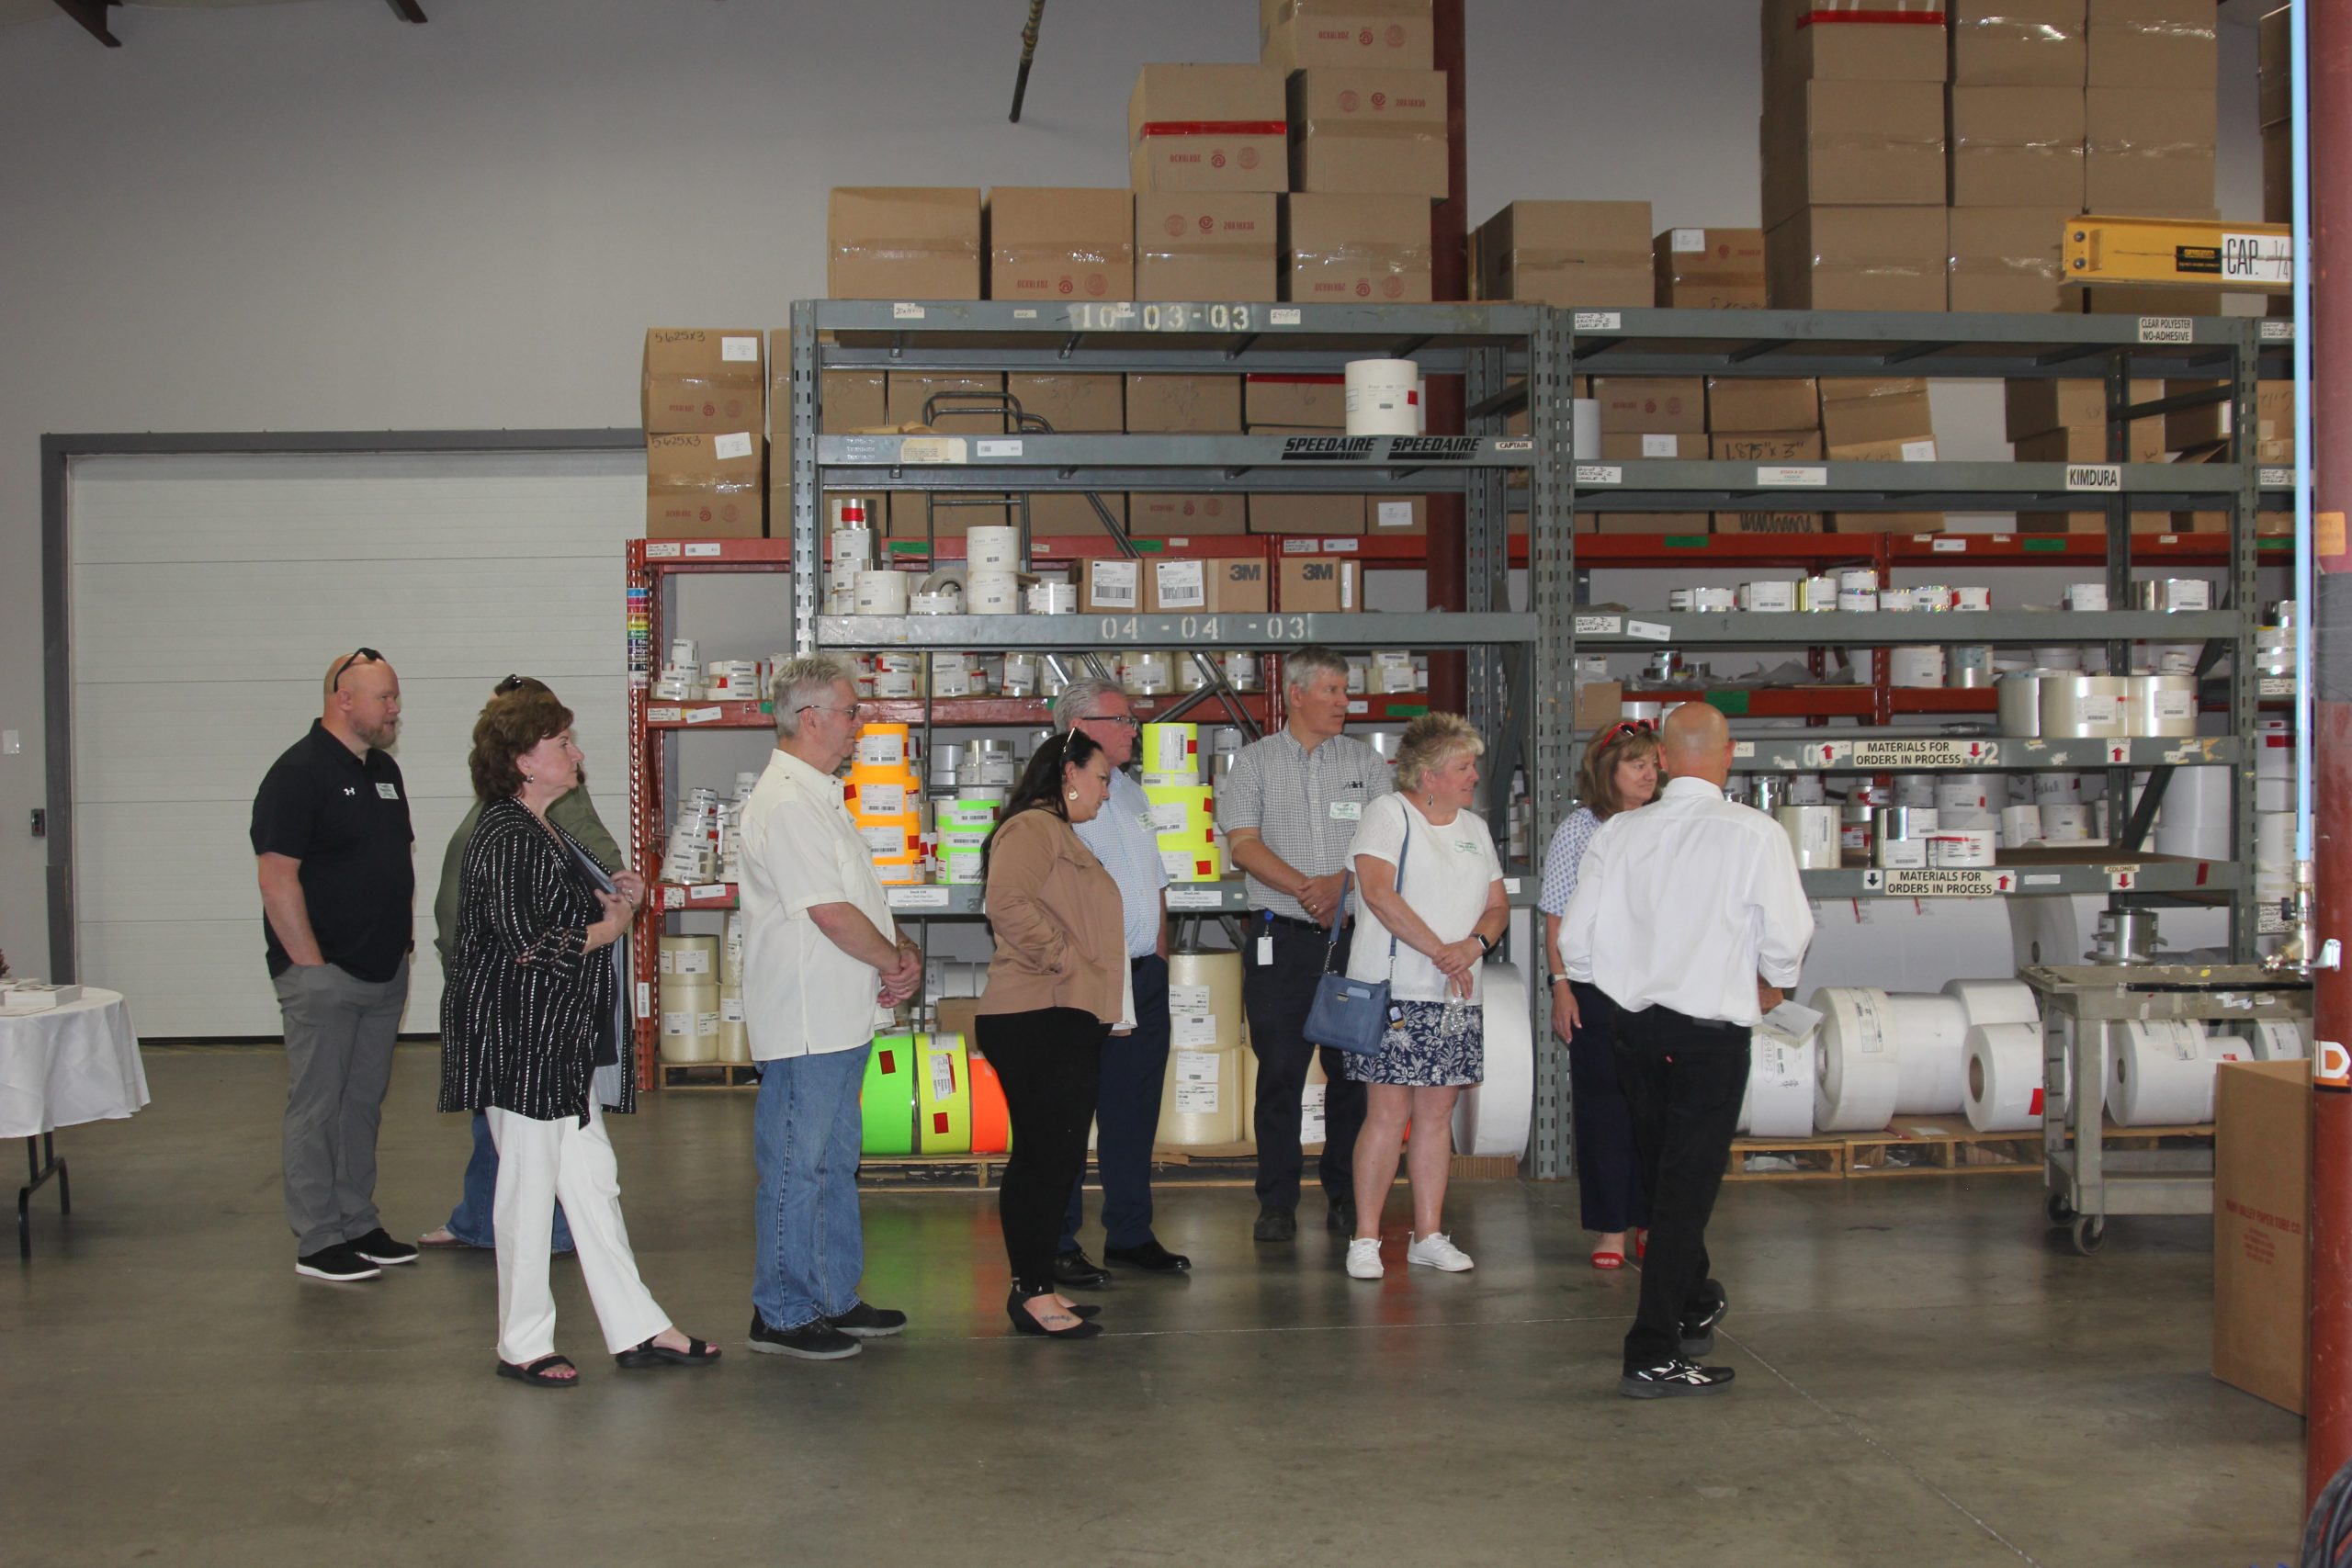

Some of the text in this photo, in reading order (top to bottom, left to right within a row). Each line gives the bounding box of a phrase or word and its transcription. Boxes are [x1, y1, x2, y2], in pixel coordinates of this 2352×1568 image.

[2227, 238, 2259, 276] CAP.
[2141, 319, 2191, 329] CLEAR POLYESTER
[2143, 330, 2189, 342] NO-ADHESIVE
[1284, 437, 1378, 452] SPEEDAIRE
[1390, 437, 1485, 452] SPEEDAIRE
[1499, 441, 1529, 449] CAPTAIN
[2069, 469, 2118, 488] KIMDURA
[1229, 564, 1261, 581] 3M
[1302, 563, 1333, 581] 3M
[1868, 742, 1950, 752] MATERIALS FOR
[1856, 754, 1961, 764] ORDERS IN PROCESS
[1900, 871, 1981, 882] MATERIALS FOR
[1888, 884, 1992, 894] ORDERS IN PROCESS
